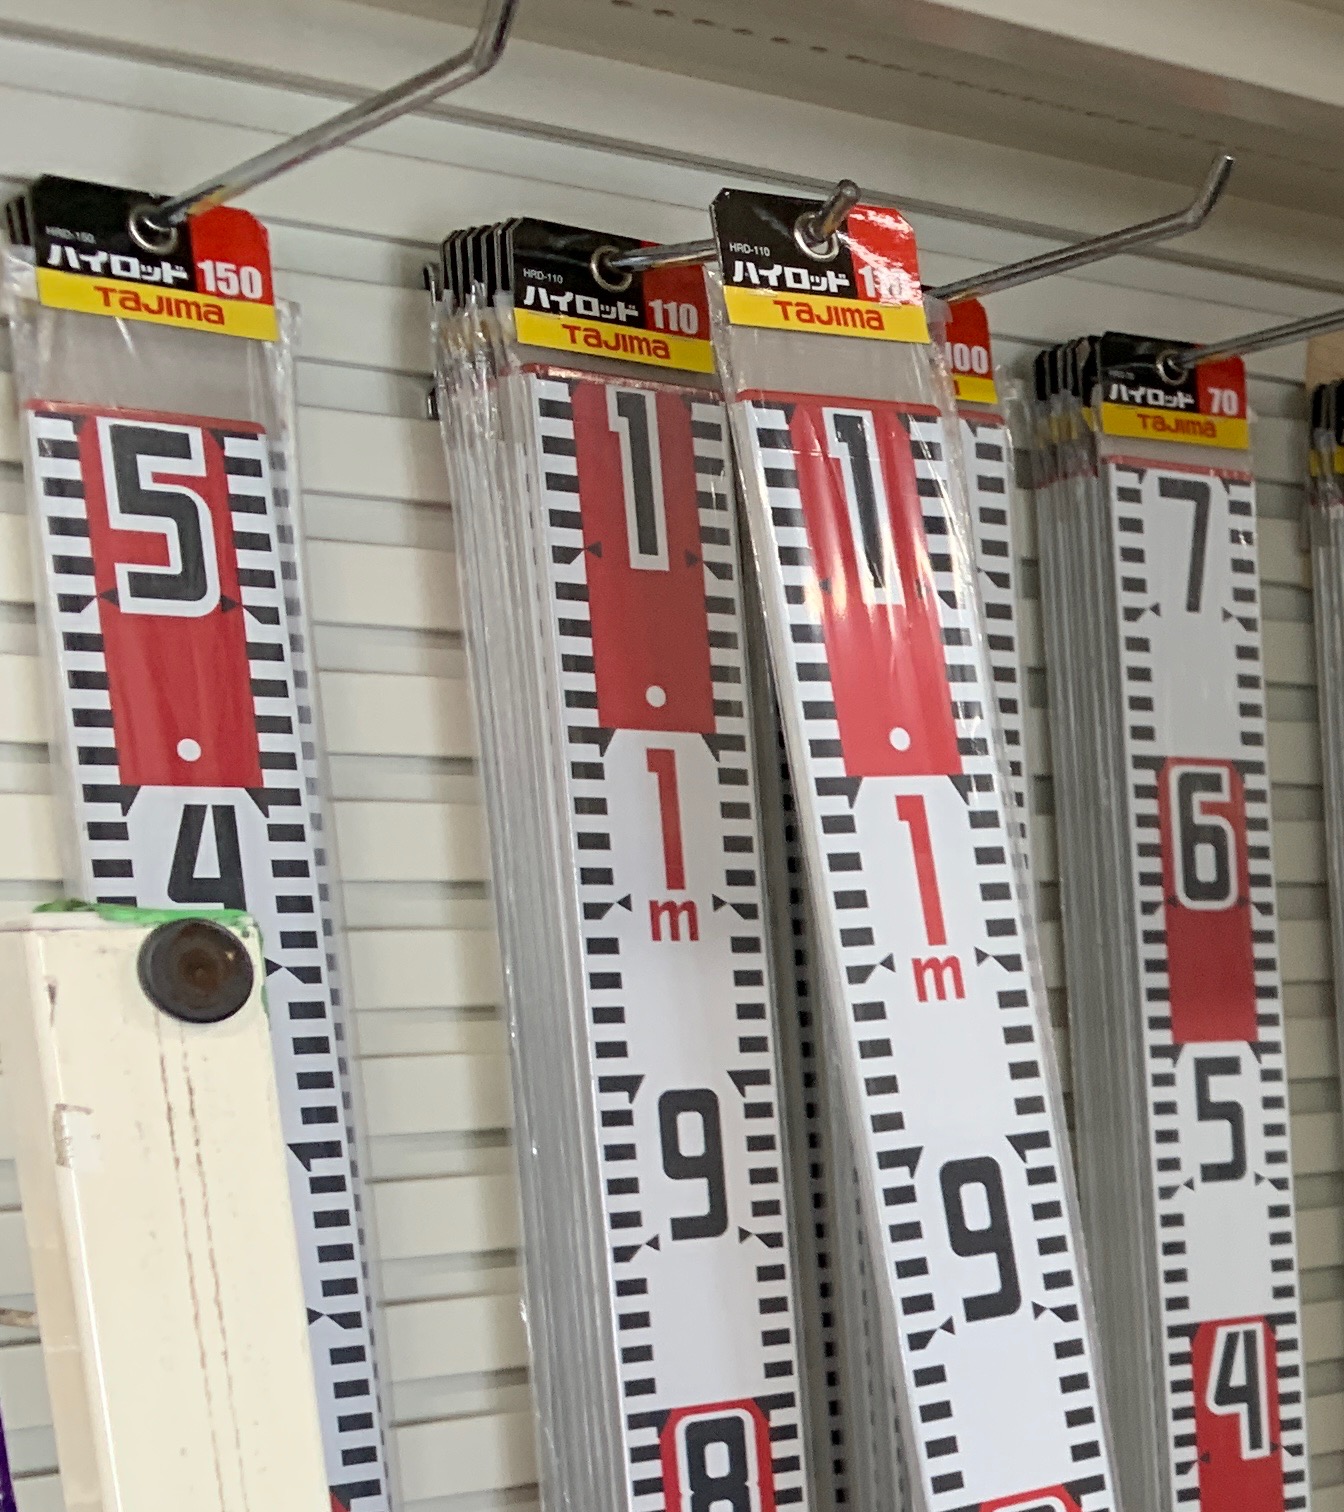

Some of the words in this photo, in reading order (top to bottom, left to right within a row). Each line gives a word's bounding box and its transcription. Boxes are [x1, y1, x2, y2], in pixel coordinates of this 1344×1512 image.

[48, 243, 189, 285] ハイロッド
[197, 259, 263, 300] 150
[523, 285, 639, 327] ハイロッド
[729, 242, 771, 257] HRD-110
[732, 259, 849, 294] ハイロッド
[648, 300, 698, 336] 110
[1207, 387, 1240, 416] 70
[98, 415, 219, 617] 5
[606, 389, 670, 571] 1
[823, 407, 905, 604] 1
[1157, 476, 1211, 612] 7
[1169, 765, 1237, 910] 6
[656, 1088, 730, 1241] 9
[1193, 1056, 1247, 1182] 5
[938, 1155, 1022, 1322] 9
[1207, 1322, 1271, 1460] 4
